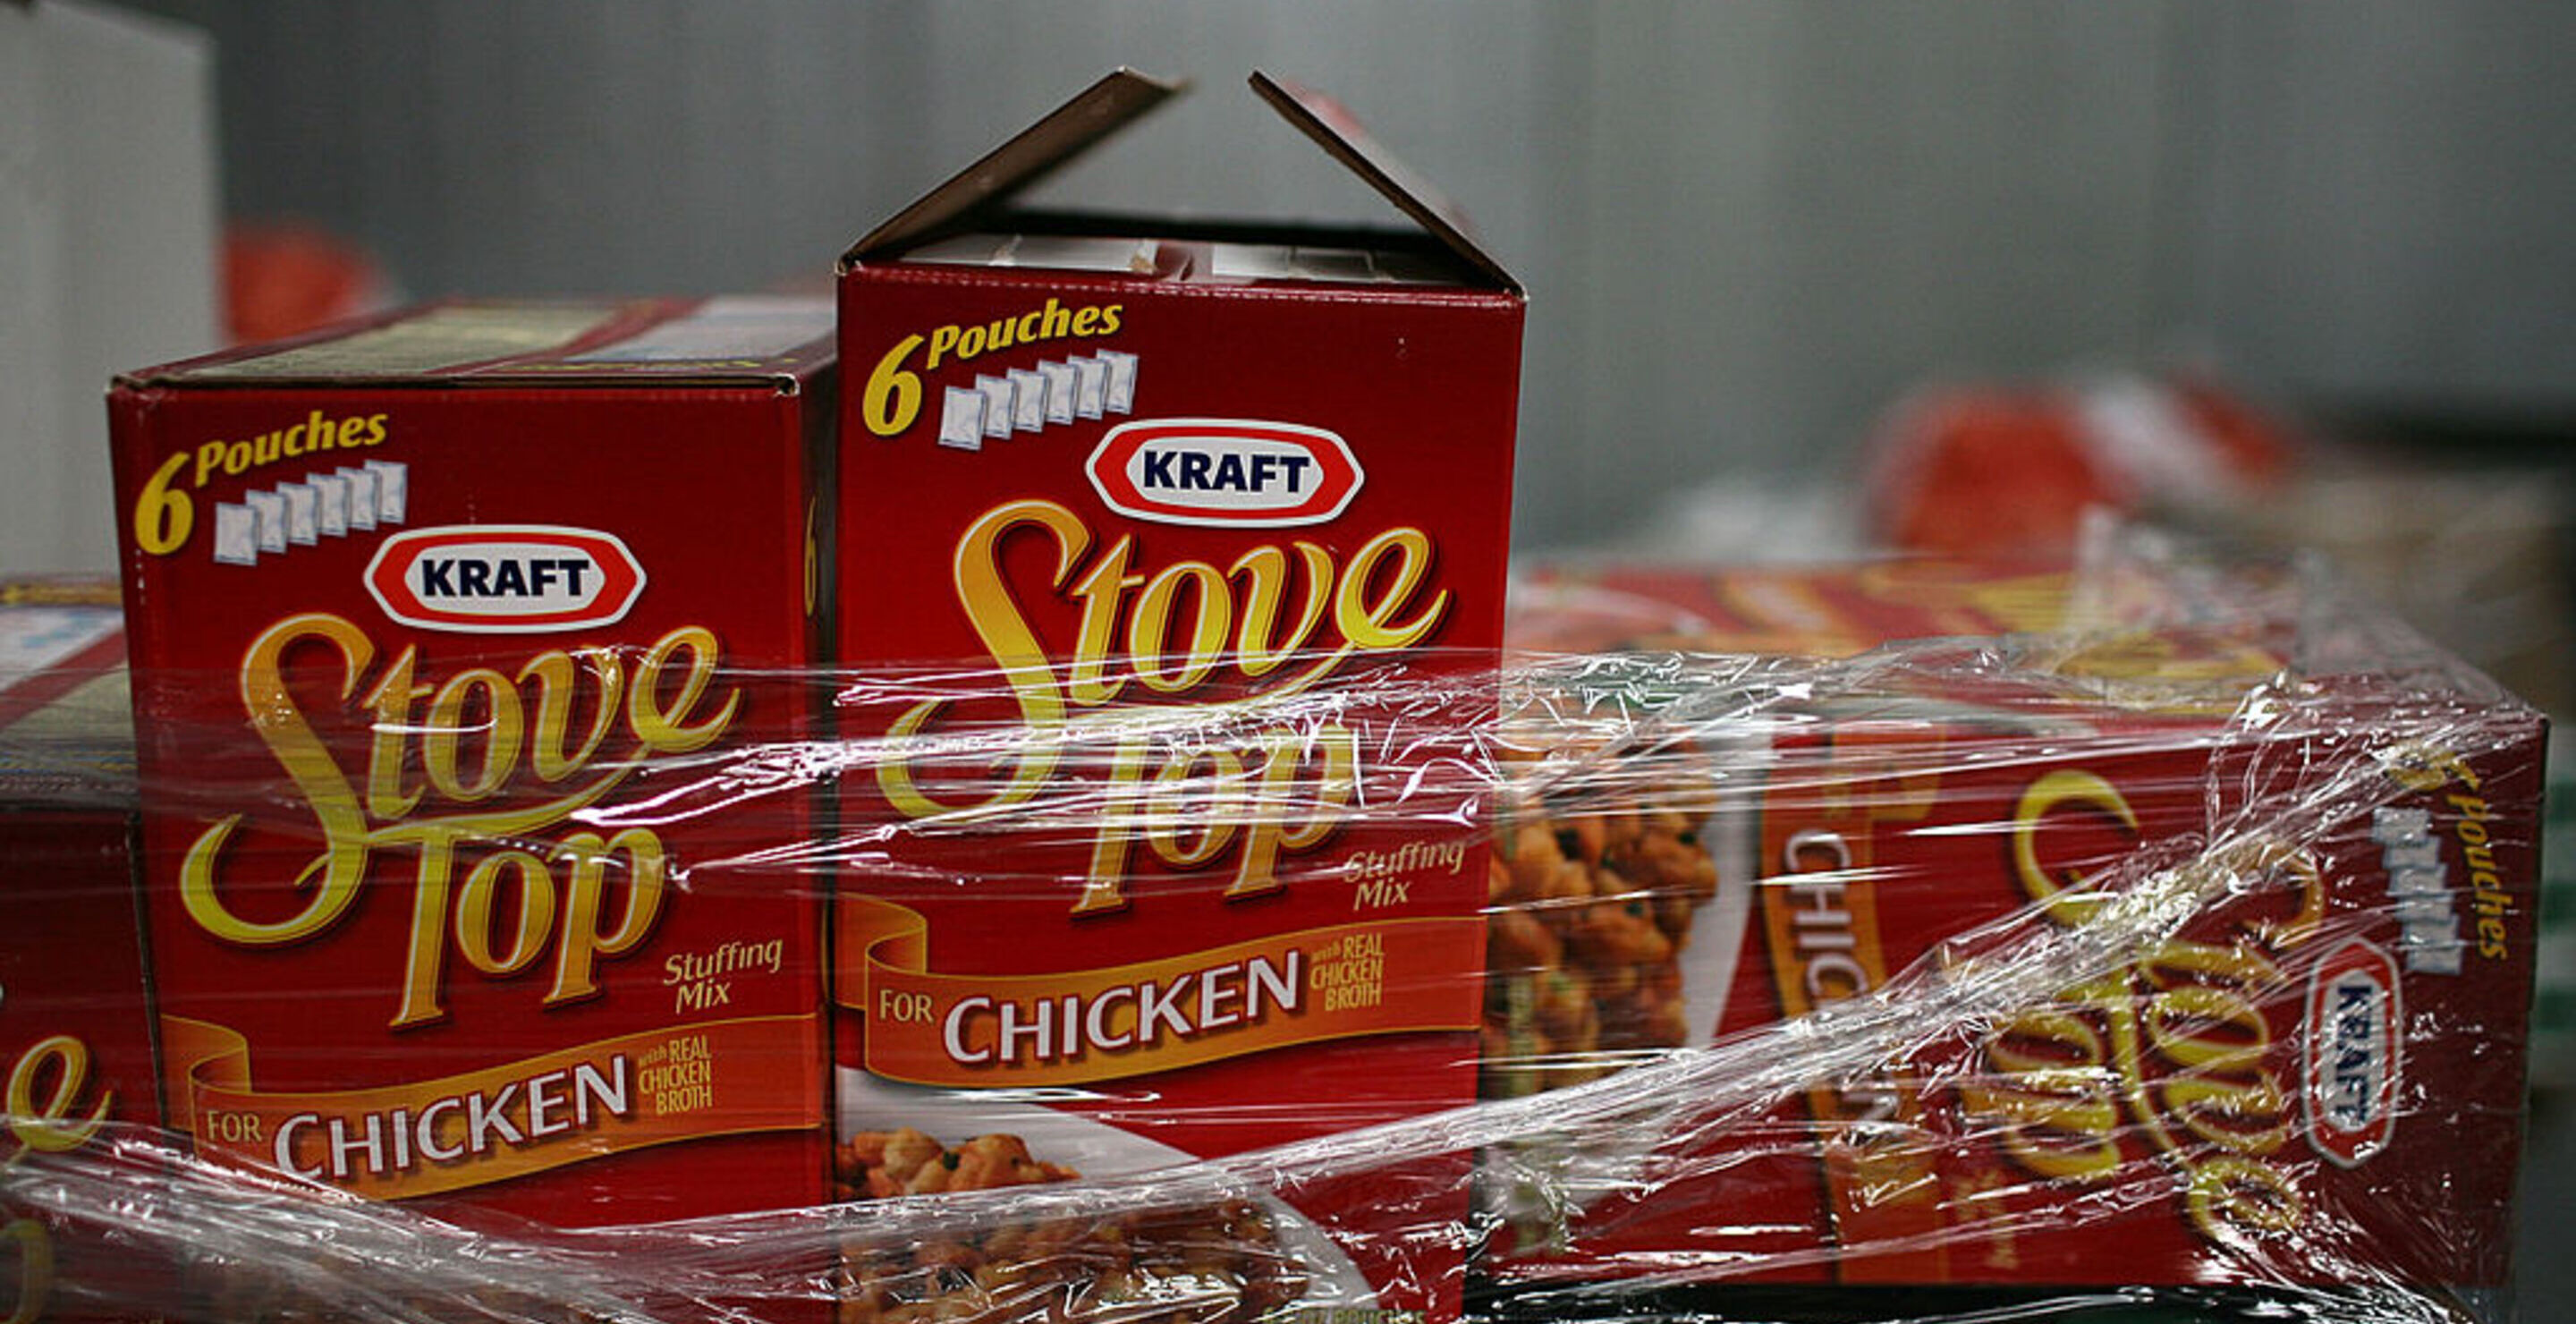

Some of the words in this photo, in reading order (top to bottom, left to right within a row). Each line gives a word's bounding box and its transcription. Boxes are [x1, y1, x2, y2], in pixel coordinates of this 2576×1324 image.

[861, 333, 924, 436] 6
[927, 298, 1124, 369] Pouches
[134, 451, 195, 556] 6
[193, 411, 388, 488] Pouches
[1142, 451, 1310, 494] KRAFT
[421, 558, 590, 598] KRAFT
[876, 499, 1448, 825] Stove
[181, 613, 741, 944] Stove
[1067, 714, 1354, 914] Top
[1343, 839, 1466, 883] Stuffing
[2448, 794, 2508, 961] Pouches
[1353, 877, 1411, 912] Mix
[371, 823, 666, 1031] Top
[1343, 933, 1385, 960] REAL
[664, 939, 783, 986] Stuffing
[1309, 959, 1383, 990] CHICKEN
[676, 978, 731, 1014] Mix
[878, 989, 935, 1023] FOR
[942, 949, 1300, 1064] CHICKEN
[1325, 982, 1382, 1011] BROTH
[669, 1035, 712, 1063] REAL
[2335, 985, 2374, 1125] KRAFT
[638, 1060, 711, 1094] CHICKEN
[207, 1110, 263, 1142] FOR
[273, 1054, 627, 1180] CHICKEN
[656, 1085, 713, 1115] BROTH
